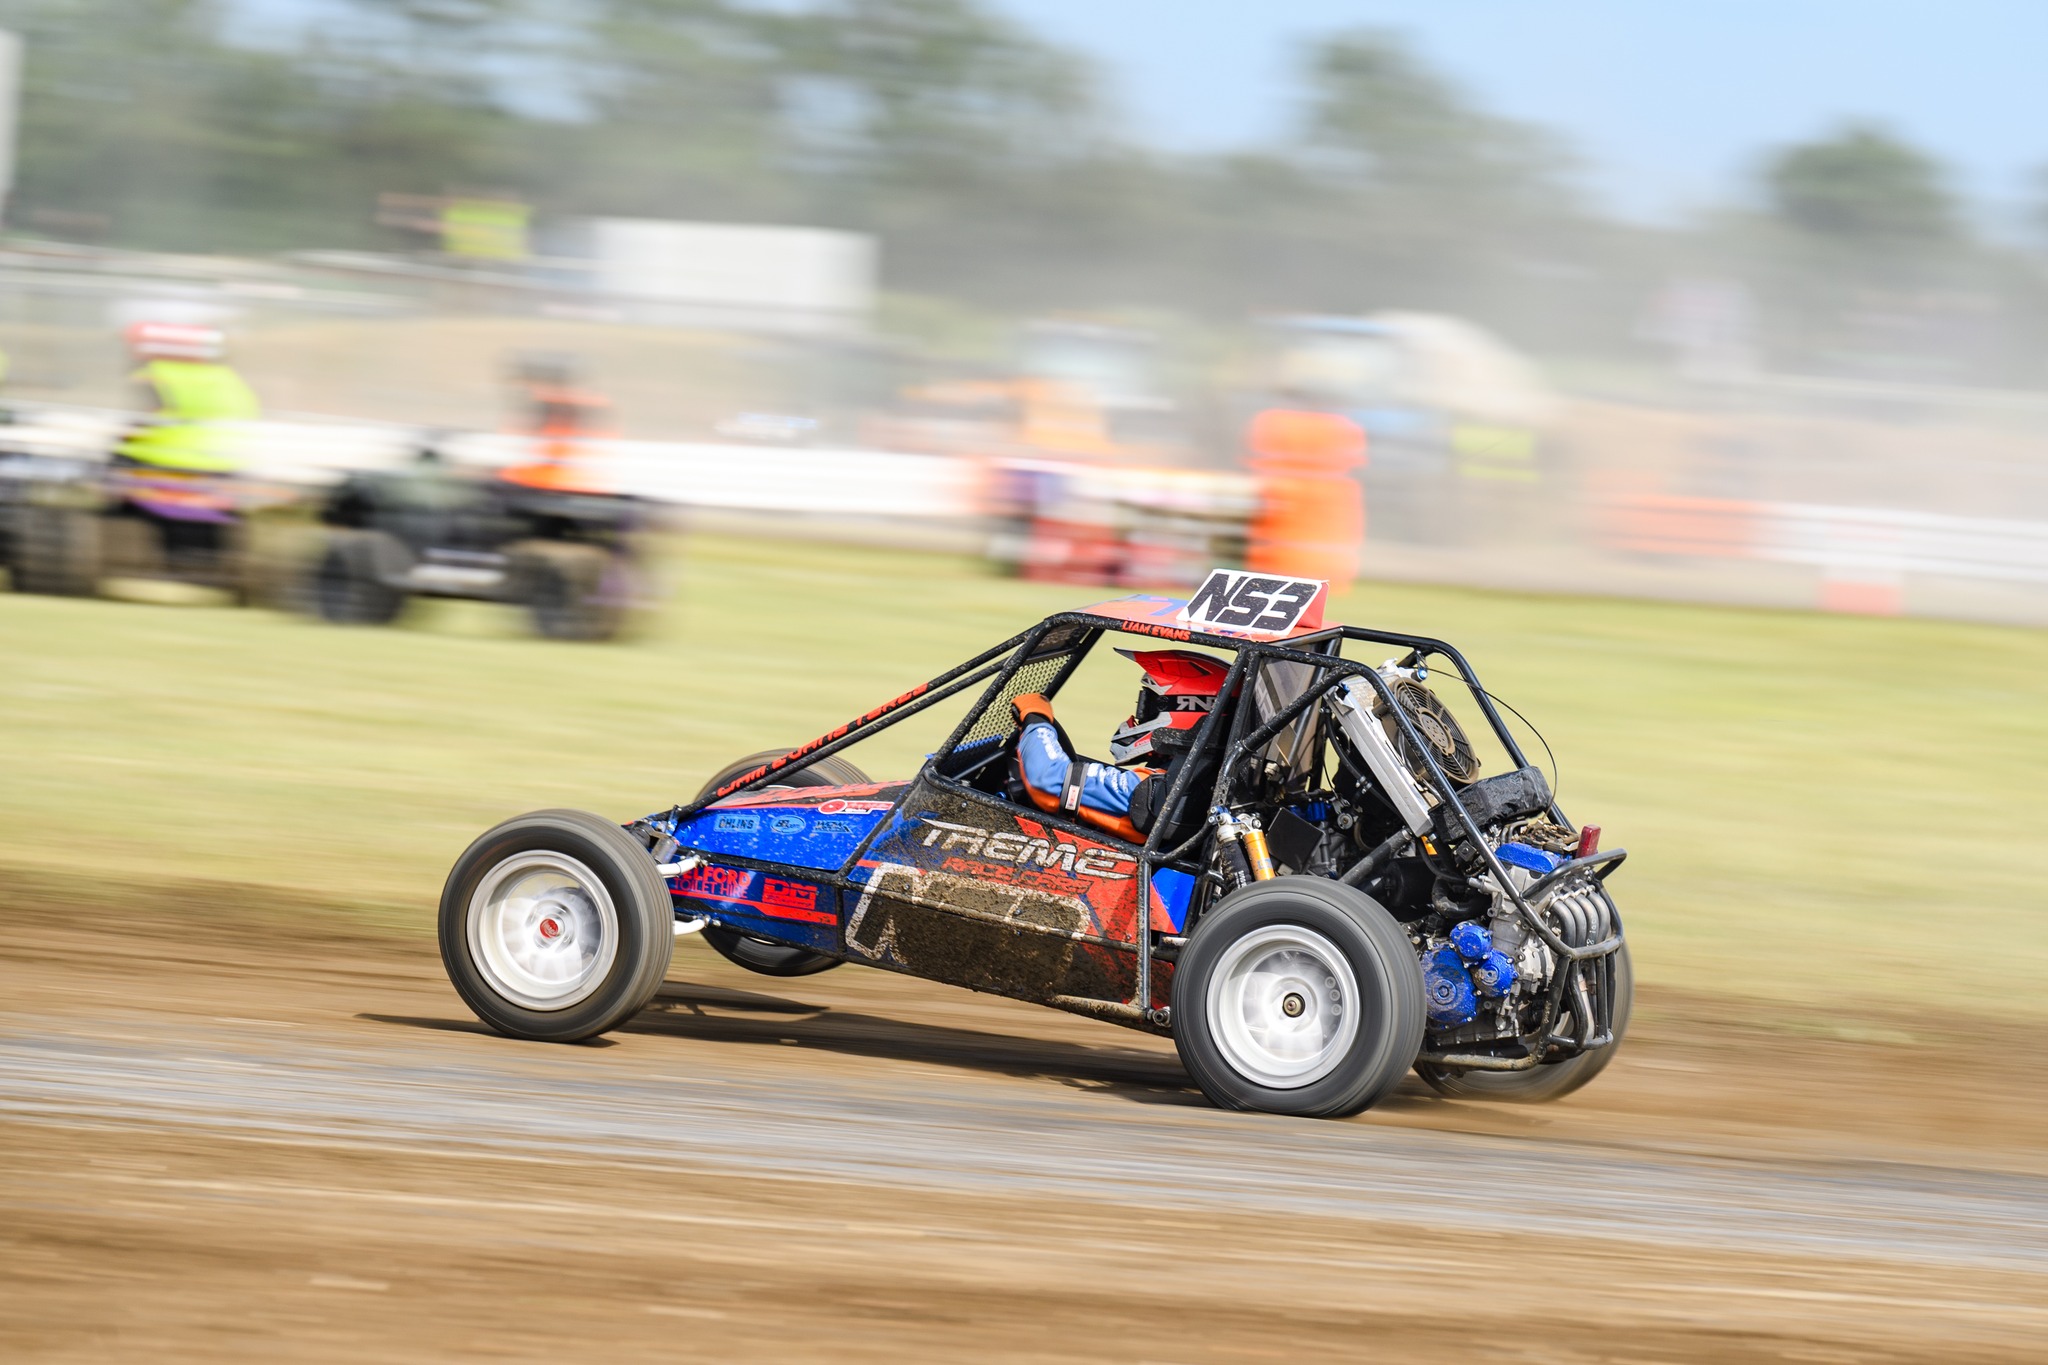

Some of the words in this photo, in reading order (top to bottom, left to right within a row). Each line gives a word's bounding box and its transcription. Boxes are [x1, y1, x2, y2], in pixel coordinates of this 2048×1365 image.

[1187, 573, 1317, 632] NS3
[1122, 620, 1151, 636] LIAM
[1151, 625, 1192, 642] EVANS
[674, 877, 717, 896] TOILET
[720, 882, 749, 899] HIRE
[764, 877, 818, 900] DM
